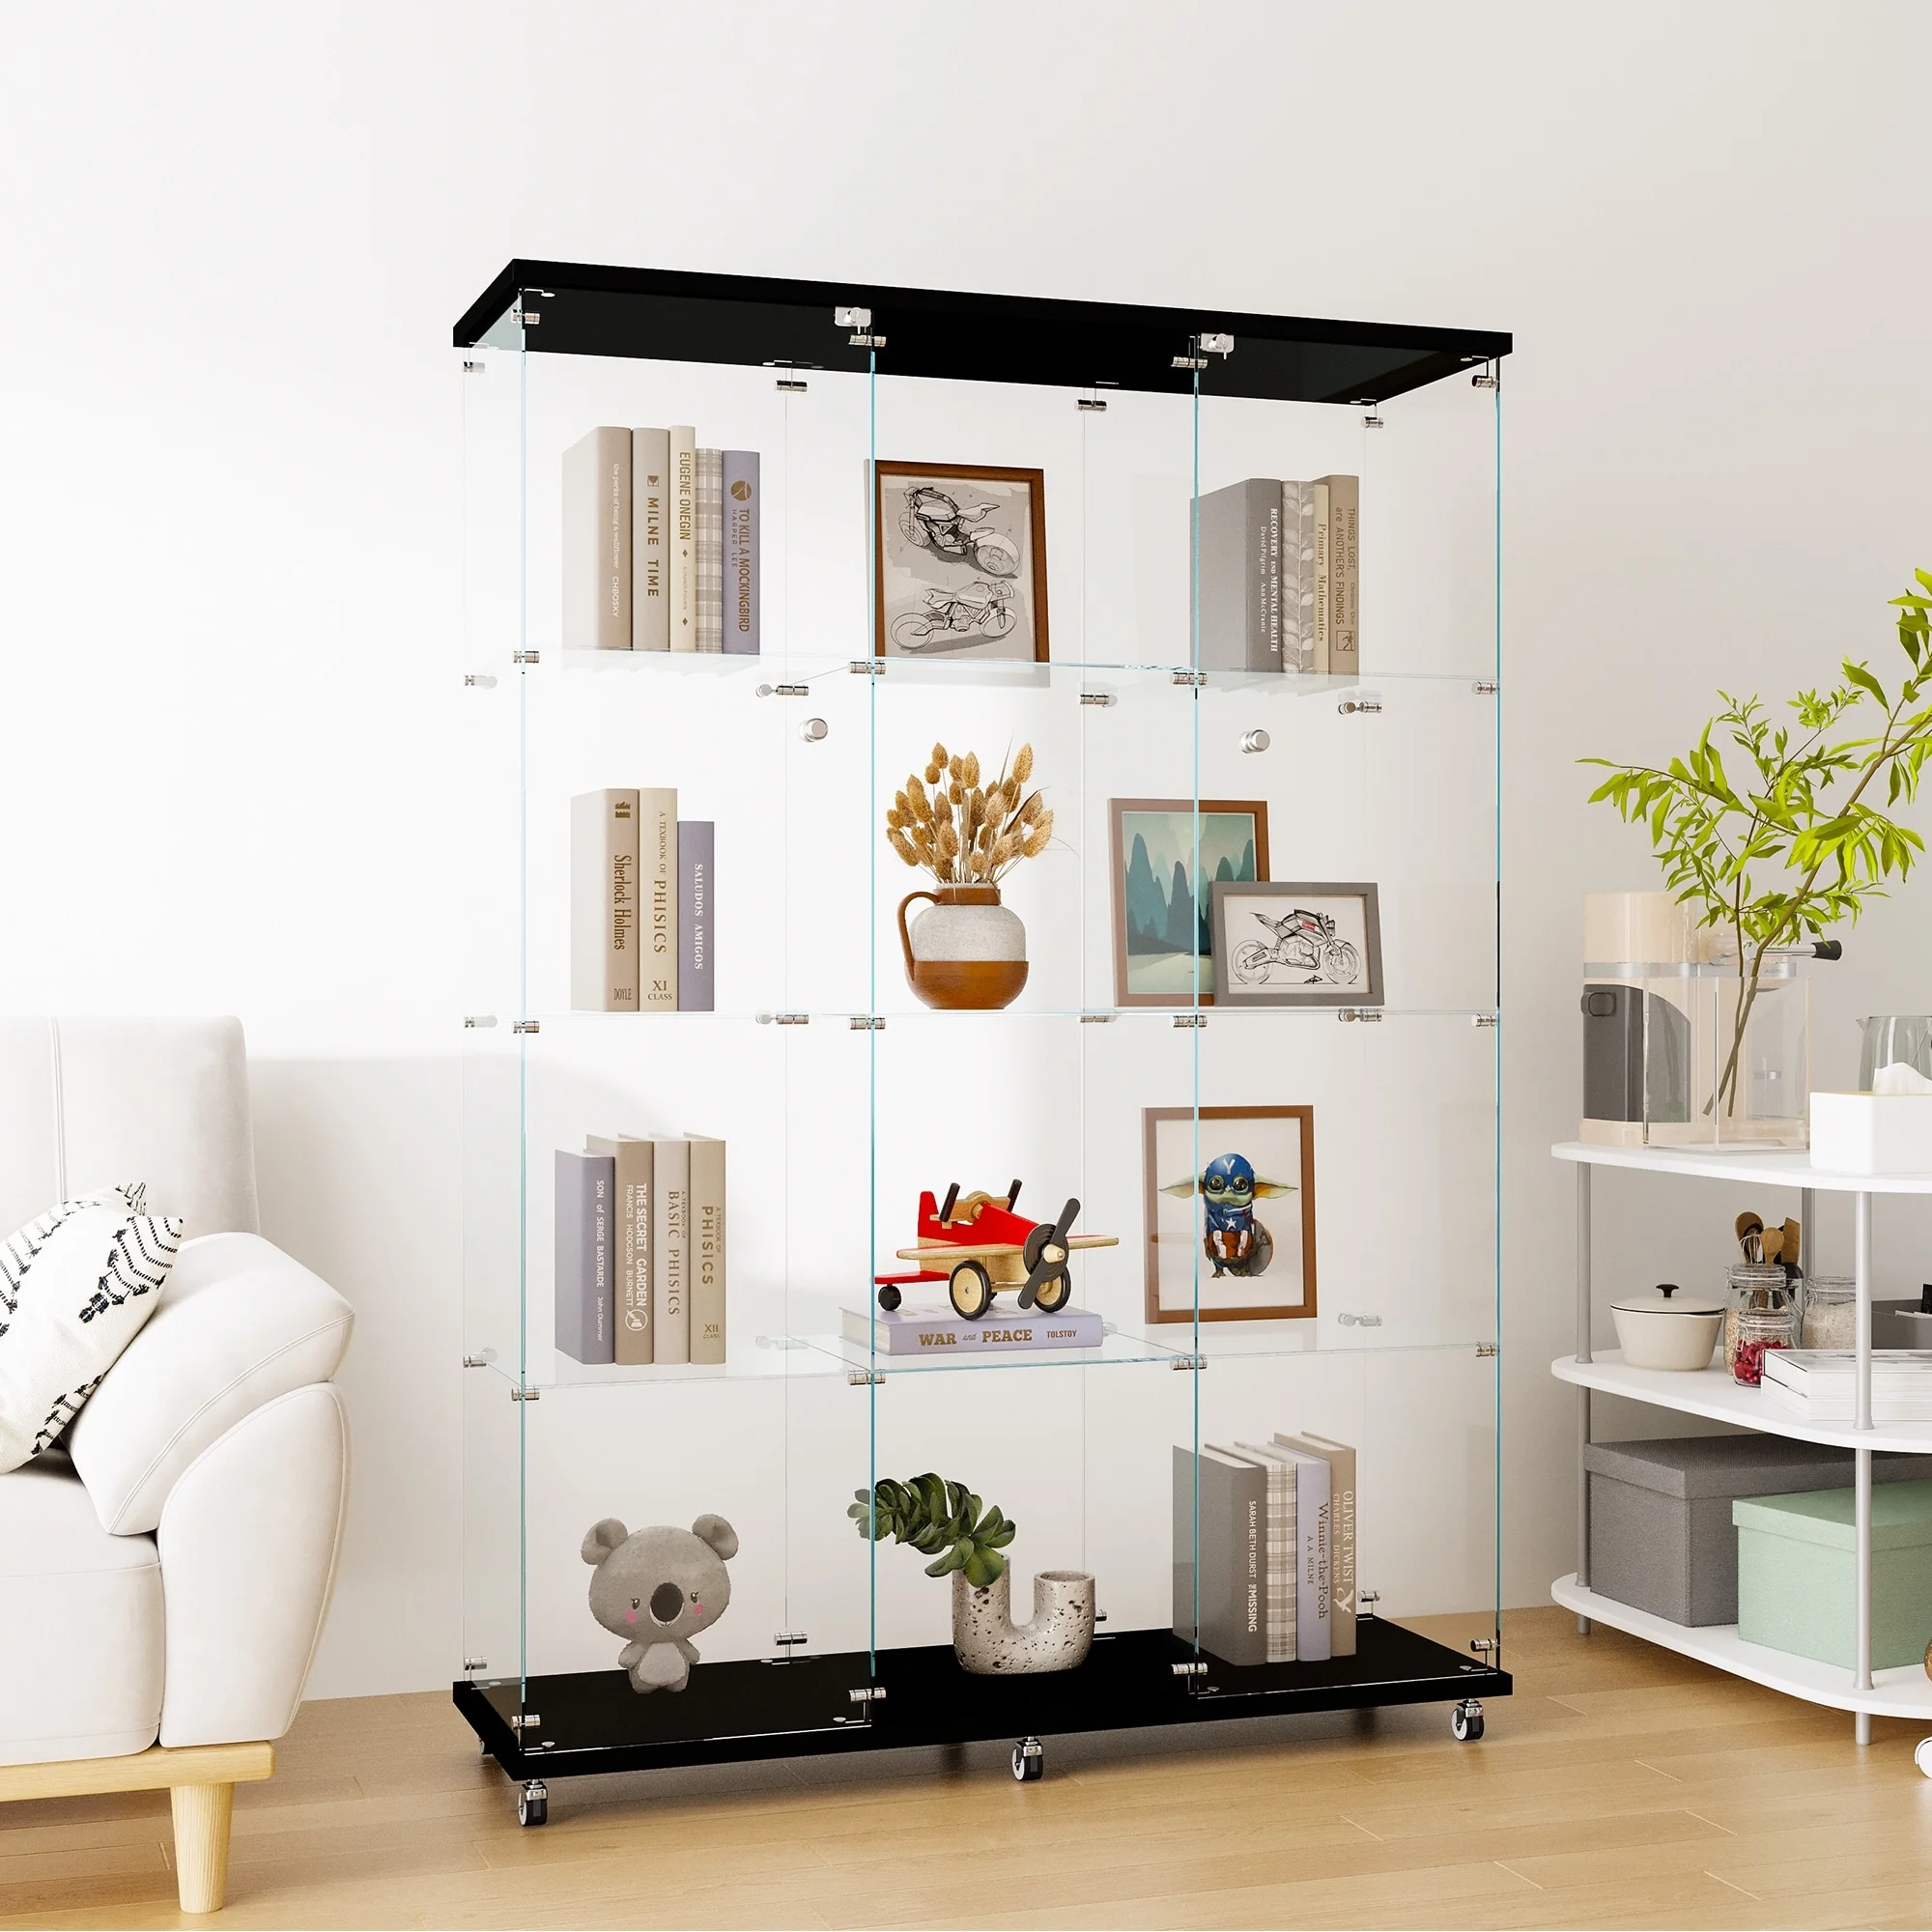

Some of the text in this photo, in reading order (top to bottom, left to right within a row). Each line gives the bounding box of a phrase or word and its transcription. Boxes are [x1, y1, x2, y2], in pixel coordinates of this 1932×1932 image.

[611, 506, 620, 525] being
[679, 452, 691, 540] EUGENE ONEGIN
[739, 508, 750, 522] TO
[648, 497, 658, 597] MILNE TIME
[739, 525, 750, 545] KILL
[1336, 527, 1345, 578] ANOTHER'S
[1259, 548, 1267, 575] Pilgrim
[1347, 546, 1355, 570] LOST,
[739, 558, 751, 632] MOCKINGBIRD
[1316, 524, 1327, 641] Primary Mathematics
[1336, 582, 1345, 625] FINDINGS
[659, 864, 666, 874] OF
[614, 855, 632, 951] Sherlock Holmes
[654, 880, 667, 953] PHISICS
[695, 864, 703, 970] SALUDOS AMIGOS
[614, 988, 632, 1001] DOYLE
[653, 980, 667, 991] XI
[597, 1204, 605, 1213] of
[637, 1183, 647, 1306] THE SECRET GARDEN
[668, 1191, 680, 1315] BASIC PHISICS
[702, 1206, 714, 1285] PHISICS
[919, 1329, 1077, 1347] WAR and PEACE TOLSTOY
[1248, 1500, 1257, 1527] SARAH
[1248, 1528, 1257, 1550] BETH
[1343, 1491, 1353, 1584] OLIVER TWIST
[1248, 1552, 1257, 1578] DURST
[1318, 1502, 1328, 1619] Winnie-the-Pooh
[1248, 1590, 1257, 1632] MISSING
